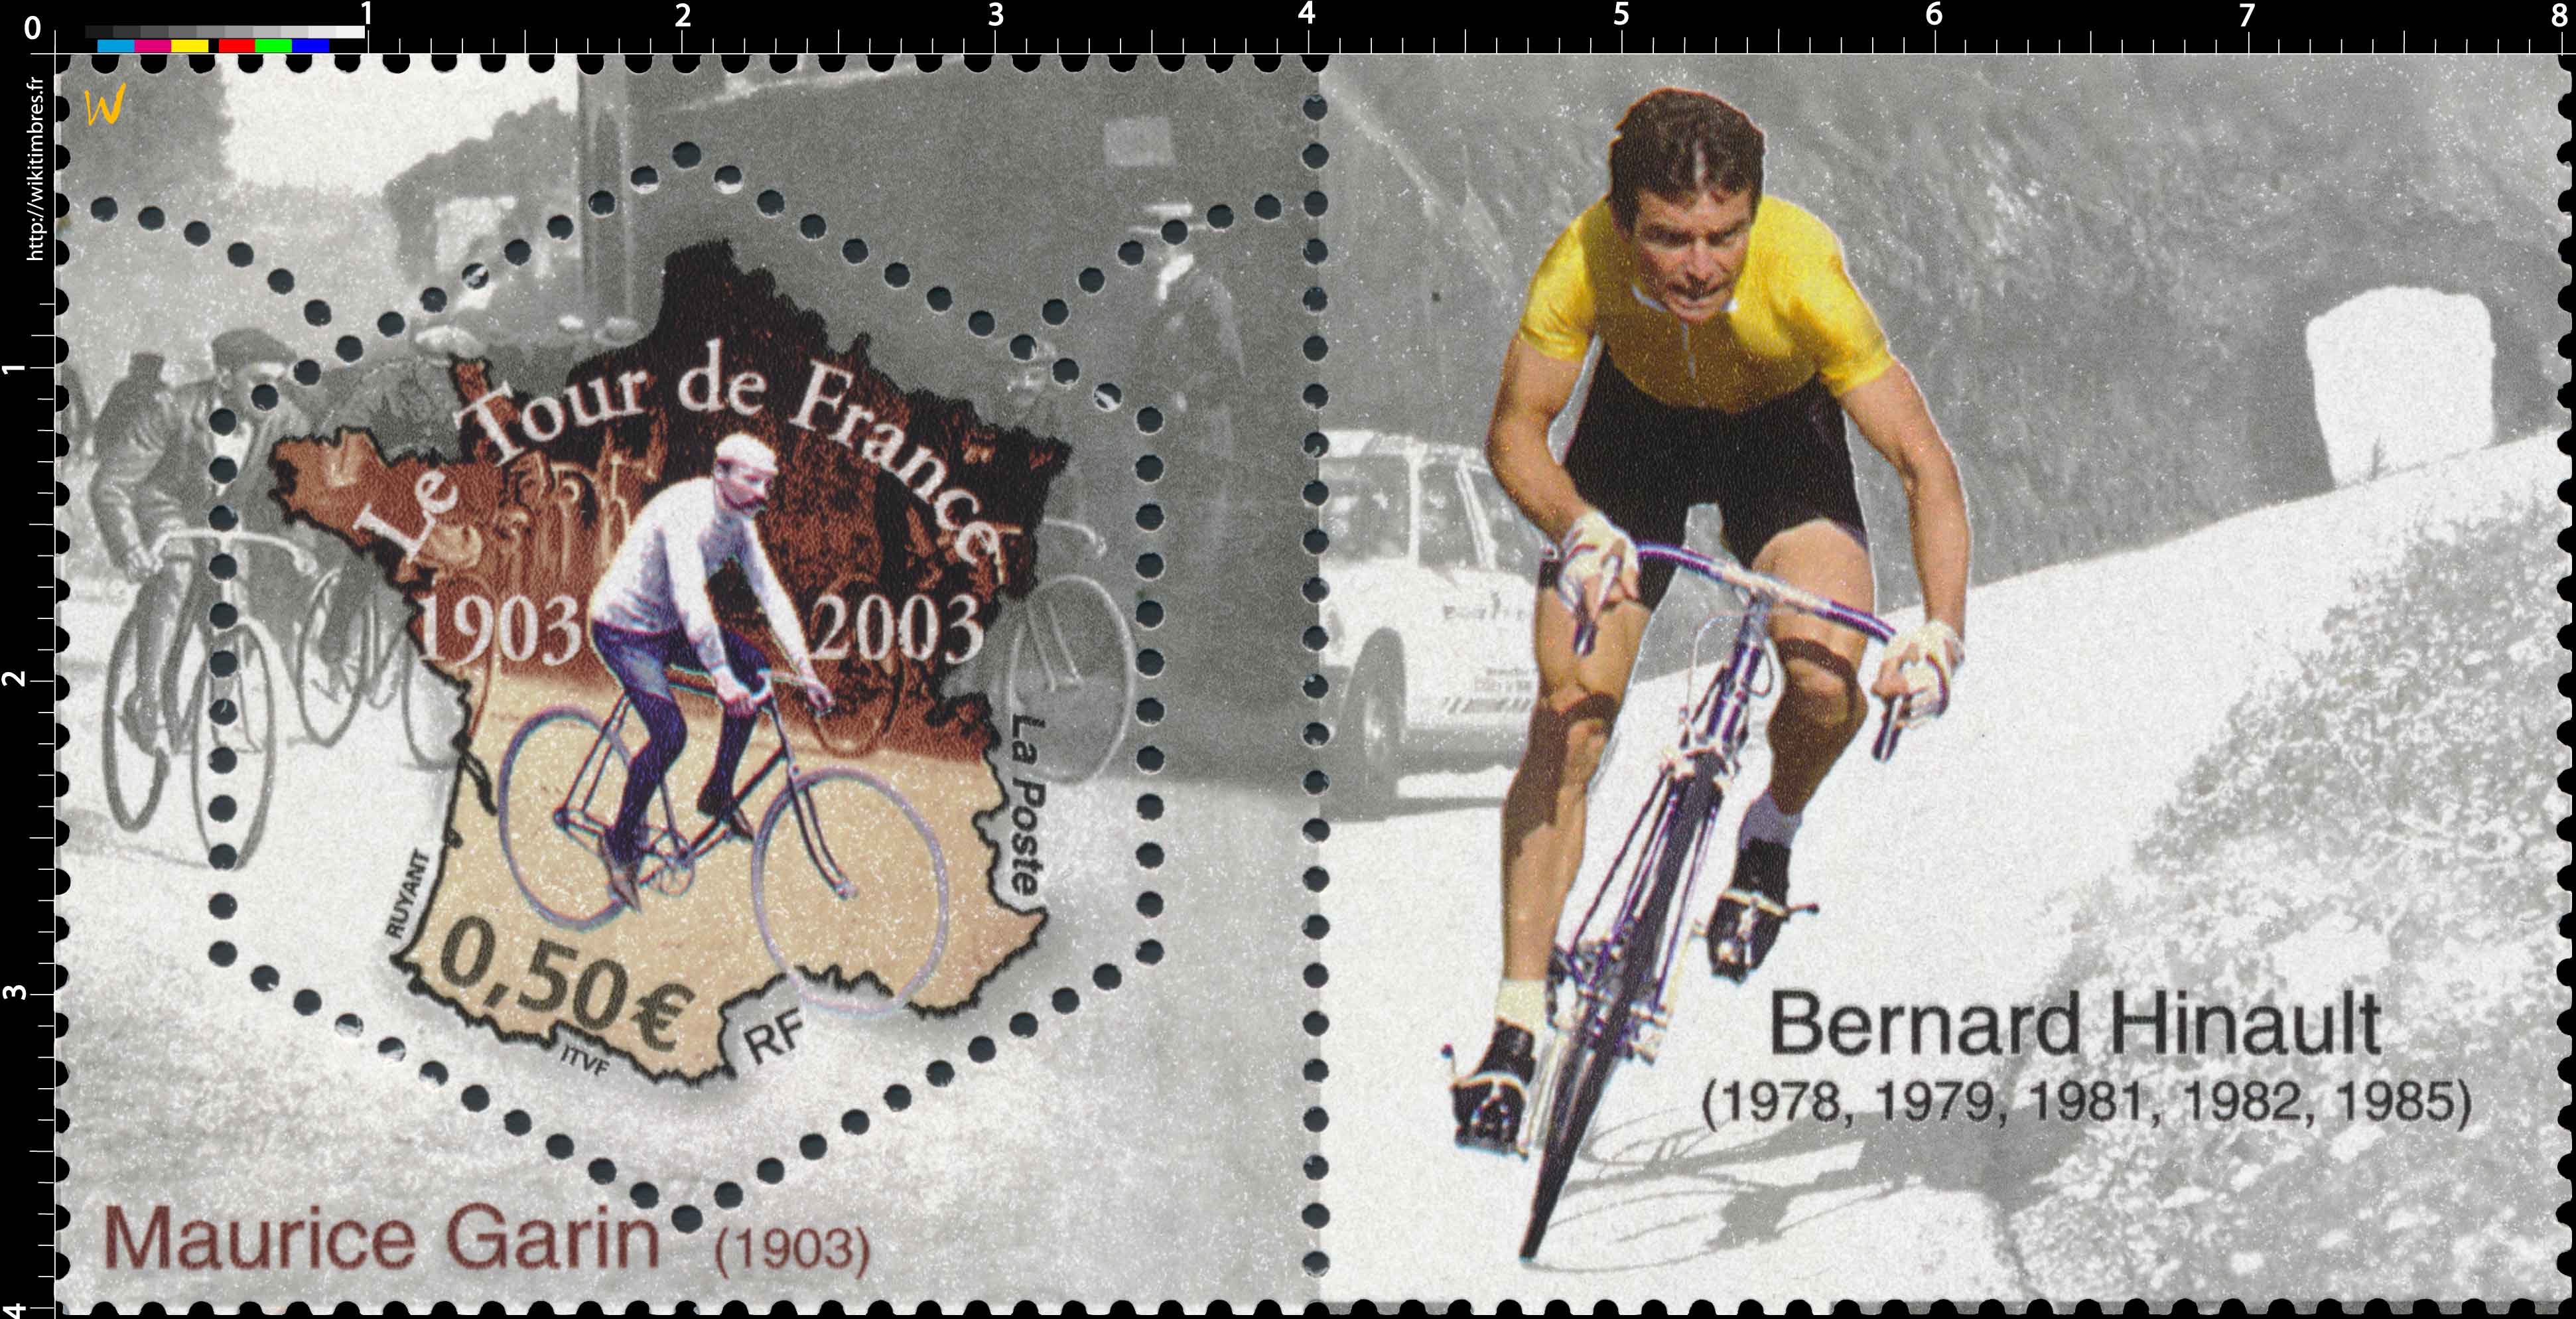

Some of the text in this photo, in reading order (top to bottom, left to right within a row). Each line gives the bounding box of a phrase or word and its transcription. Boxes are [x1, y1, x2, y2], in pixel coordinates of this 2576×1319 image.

[352, 338, 1001, 564] Le Tour de France
[419, 594, 581, 666] 1903
[809, 594, 984, 665] 2003
[1012, 714, 1046, 896] La Poste
[385, 849, 430, 939] RUYANT
[440, 916, 695, 1052] 0,50€
[744, 1007, 803, 1066] RF
[1773, 990, 2382, 1056] Bernard Hinault
[560, 1043, 610, 1076] ITVF
[1702, 1079, 2473, 1131] (1978, 1979, 1981, 1982, 1985)
[105, 1202, 871, 1279] Maurice Garin (1903)
